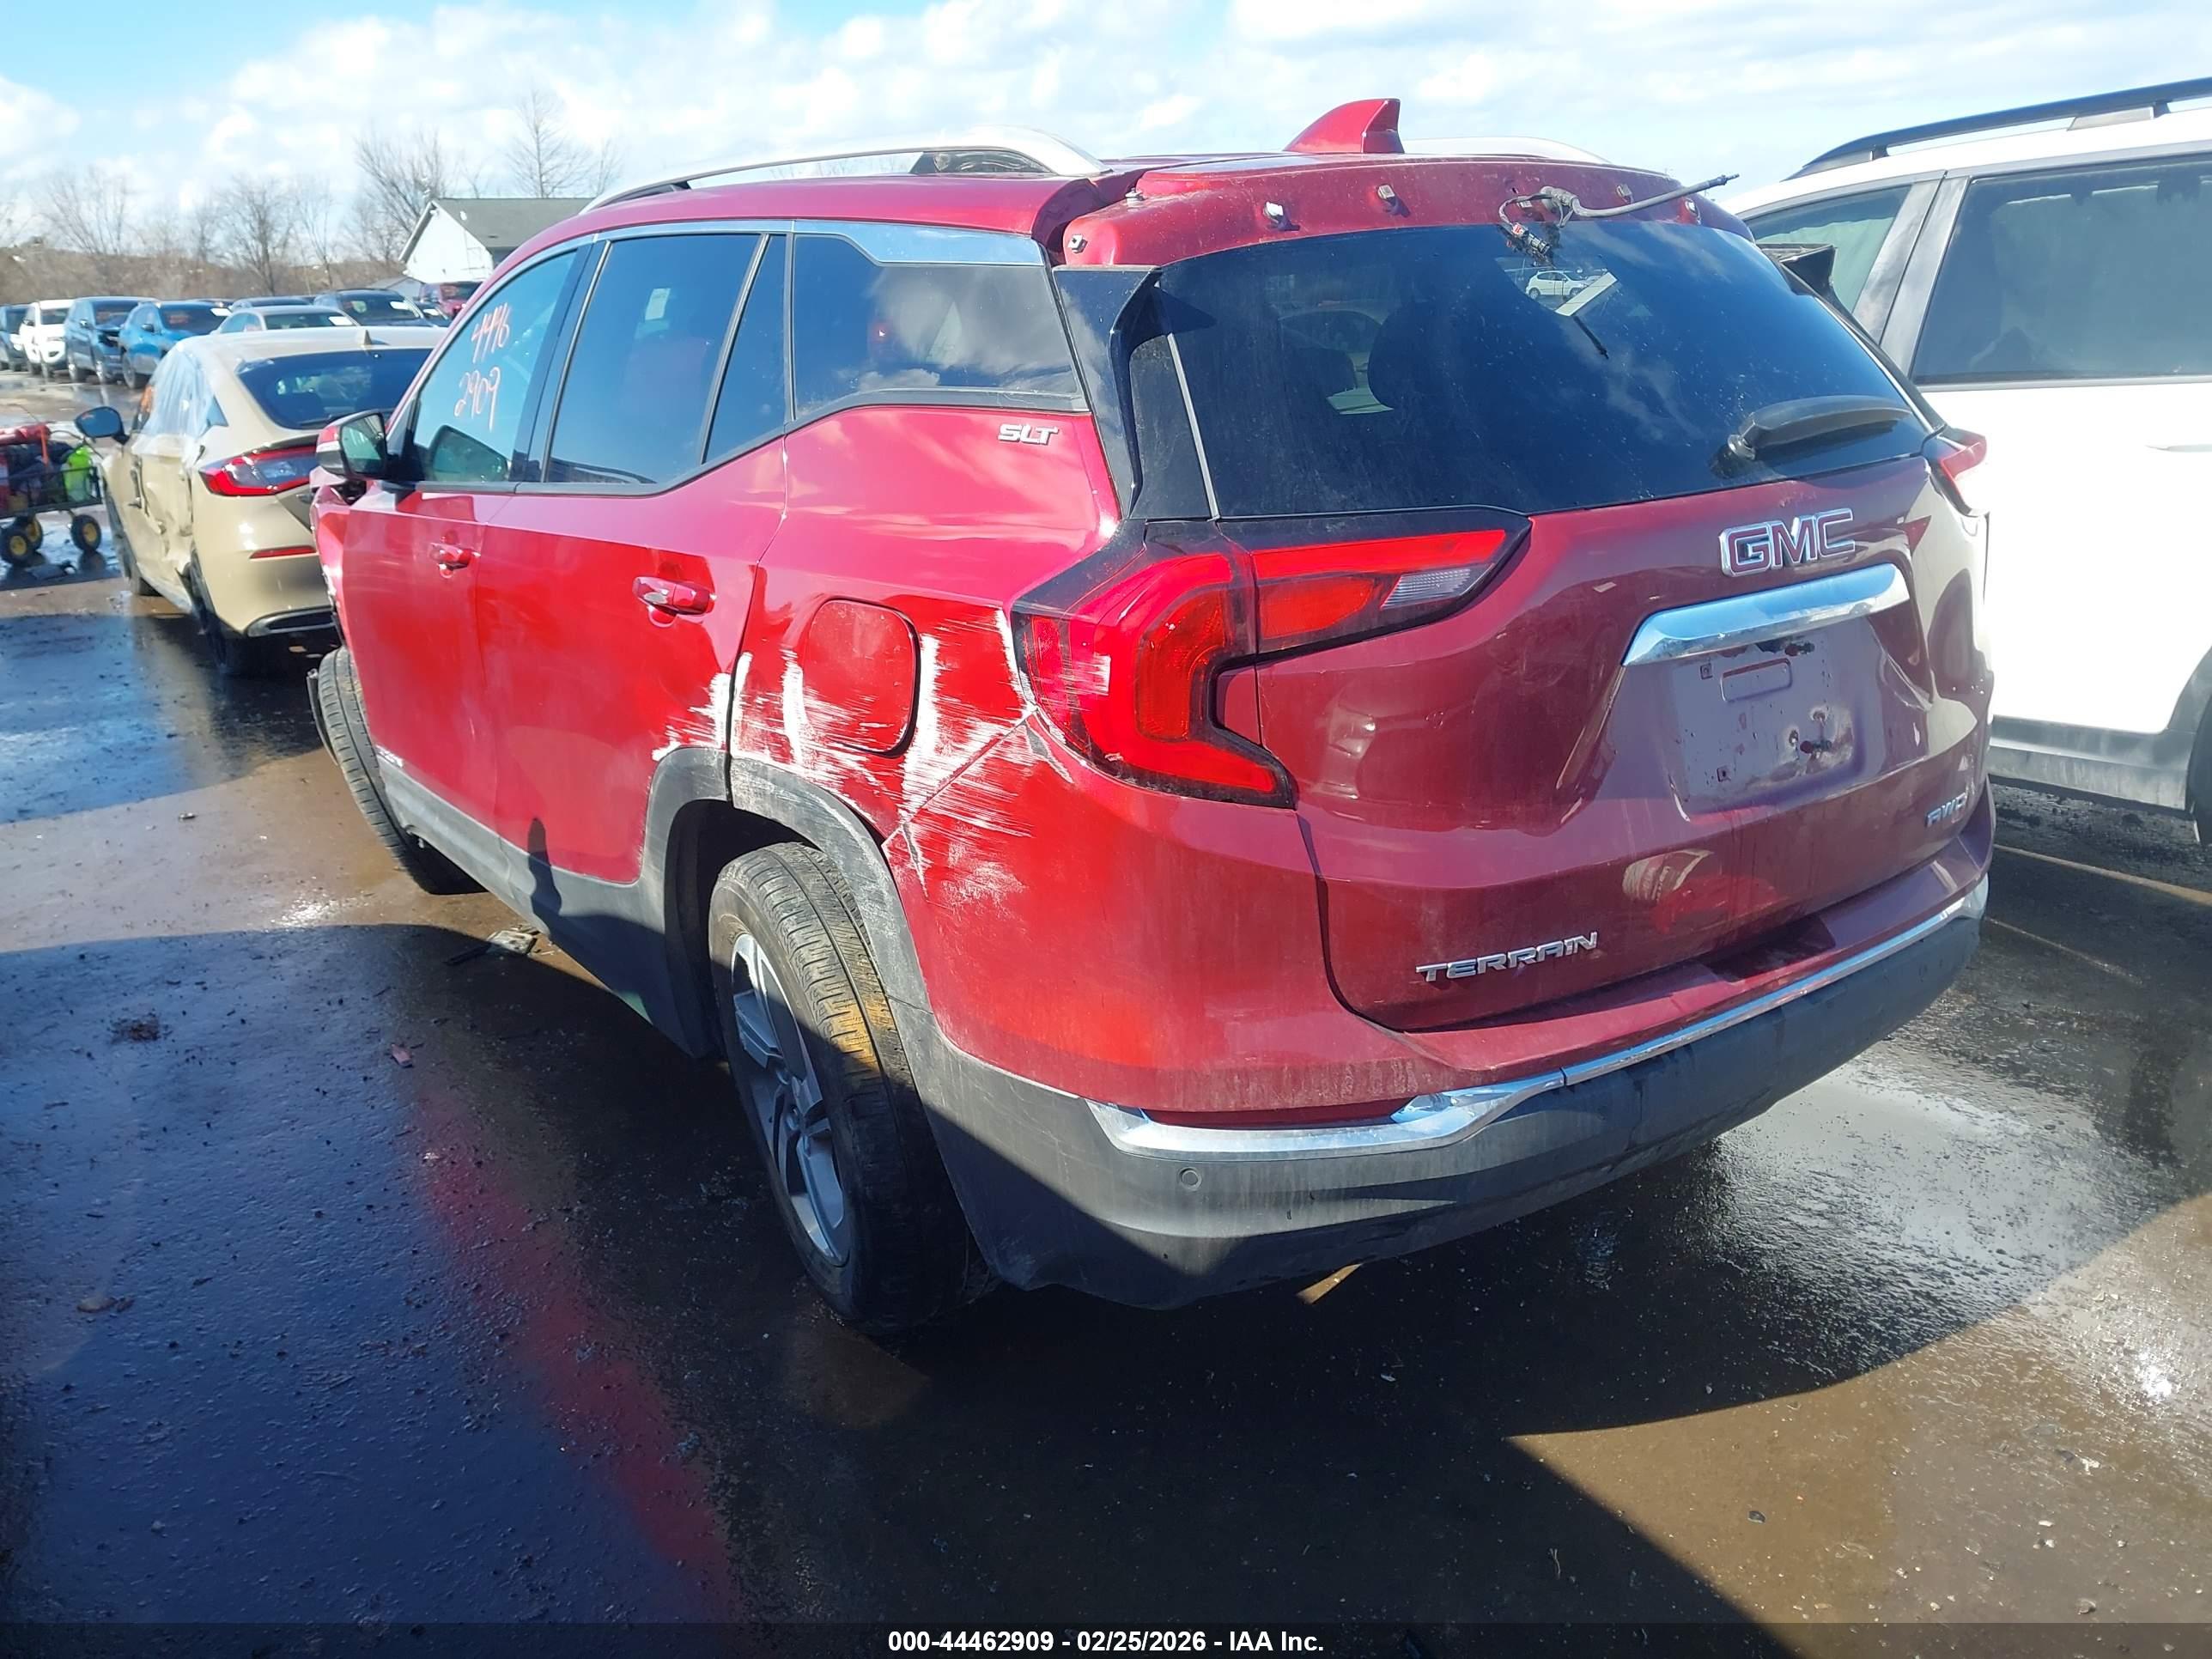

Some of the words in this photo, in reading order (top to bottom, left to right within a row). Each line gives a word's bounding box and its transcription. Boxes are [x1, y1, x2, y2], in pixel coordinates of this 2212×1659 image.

[453, 367, 501, 432] 2909
[997, 423, 1060, 446] SLT
[1718, 507, 1856, 577] GMC
[1924, 792, 1968, 827] AWD
[1416, 931, 1598, 983] TERRAIN
